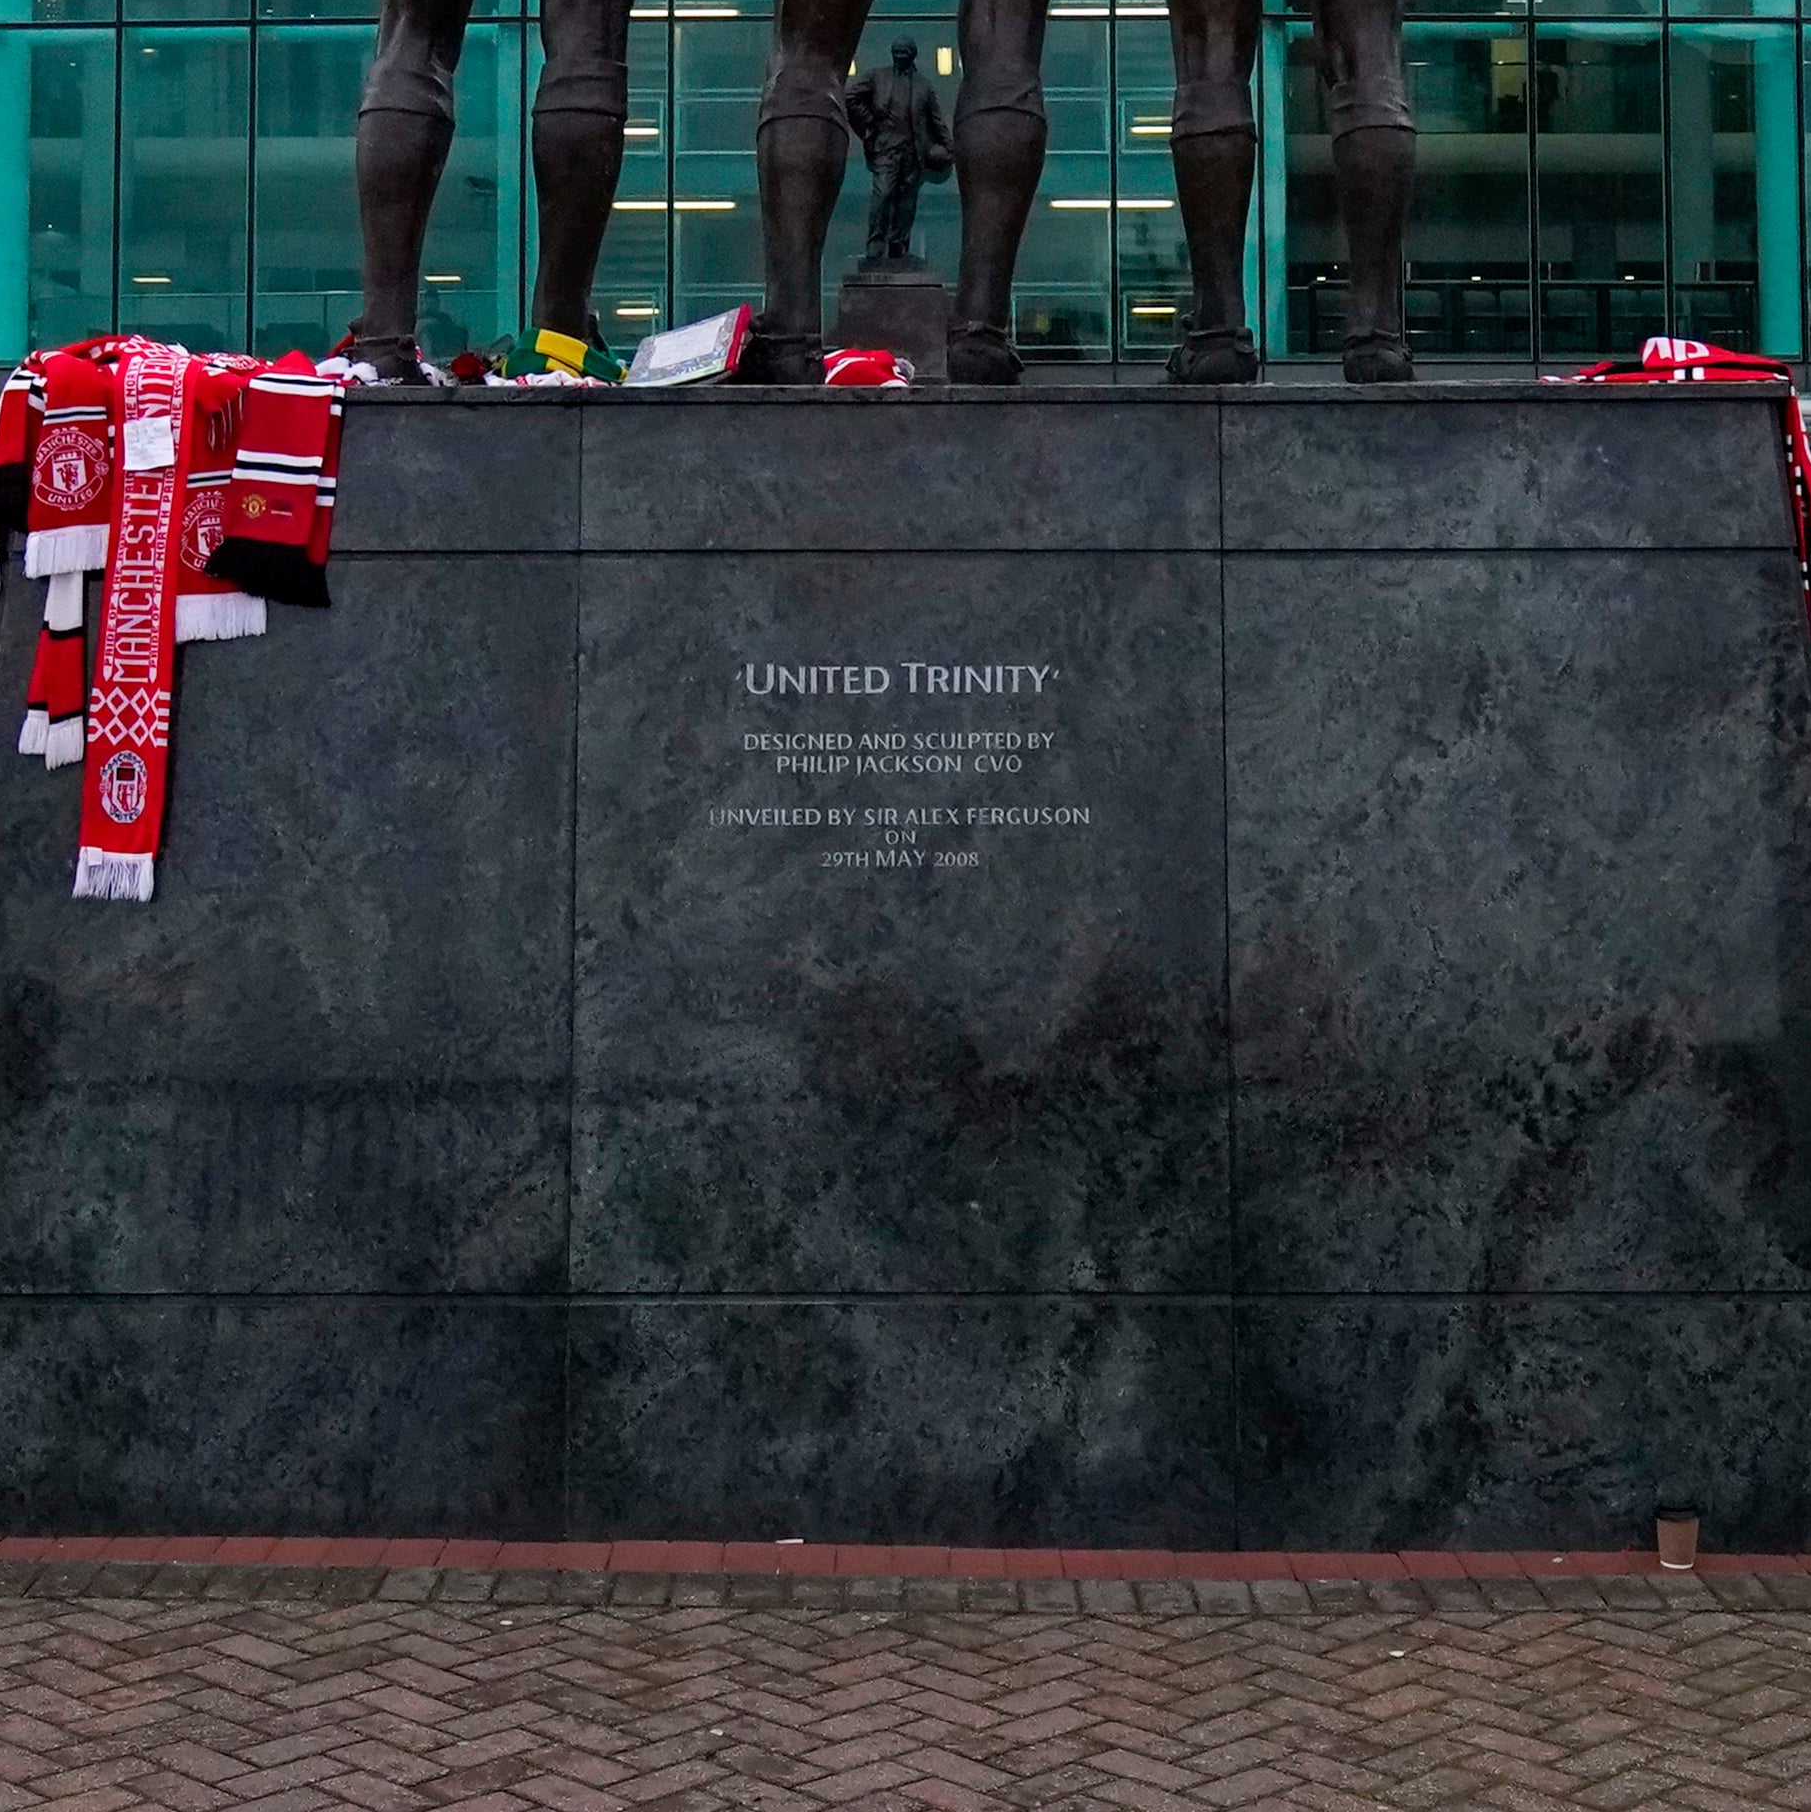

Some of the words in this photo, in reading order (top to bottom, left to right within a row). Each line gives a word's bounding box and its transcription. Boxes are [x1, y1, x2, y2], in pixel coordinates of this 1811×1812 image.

[137, 355, 177, 420] NITED
[112, 470, 165, 683] MANCHESTE
[743, 732, 853, 751] DESIGNED
[858, 733, 906, 750] AND
[912, 732, 1022, 750] SCULPTED
[1027, 731, 1055, 750] BY
[776, 755, 849, 774] PHILIP
[856, 755, 962, 776] JACKSON
[973, 754, 1023, 774] CVO
[709, 808, 822, 826] UNVEILED
[828, 808, 856, 826] BY
[864, 808, 899, 826] SIR
[906, 808, 960, 825] ALEX
[967, 806, 1090, 825] FERGUSON
[885, 830, 917, 844] ON
[821, 851, 869, 868] 29TH
[876, 849, 927, 868] MAY
[933, 851, 980, 868] 2008
